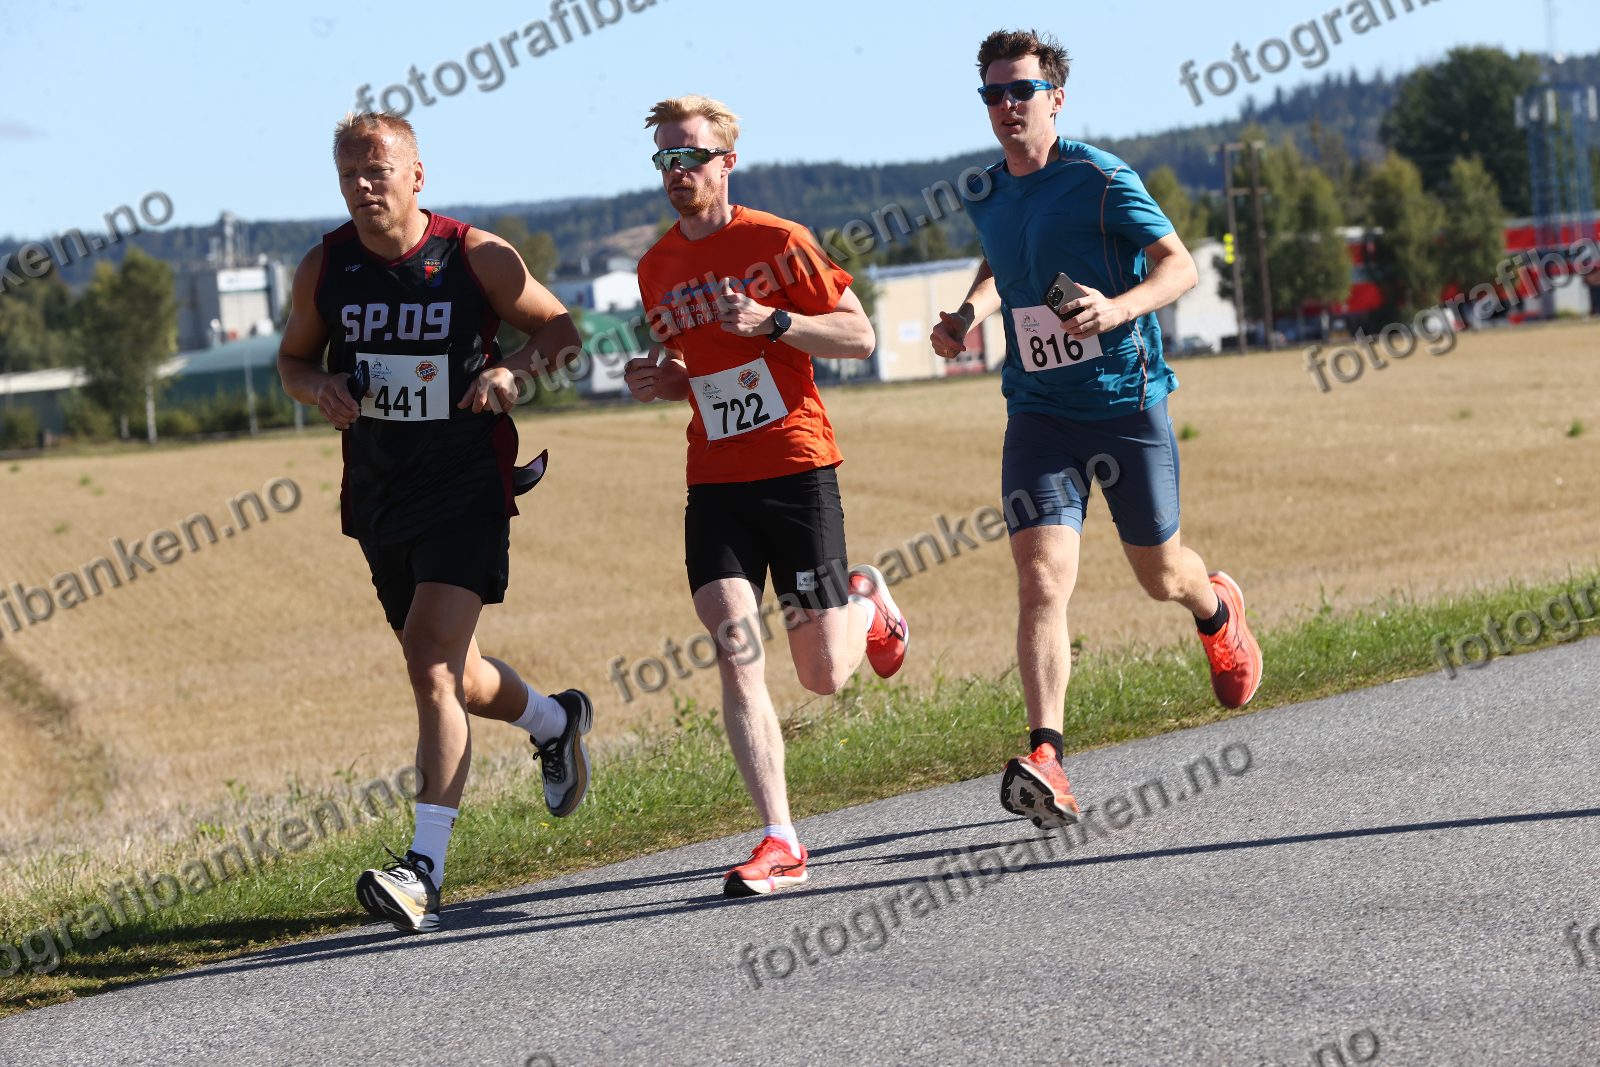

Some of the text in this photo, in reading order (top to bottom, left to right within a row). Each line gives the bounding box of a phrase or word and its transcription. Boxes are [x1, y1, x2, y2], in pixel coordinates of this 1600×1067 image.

[341, 301, 452, 342] SP.09
[1029, 332, 1084, 368] 816
[374, 385, 428, 418] 441
[712, 392, 771, 435] 722
